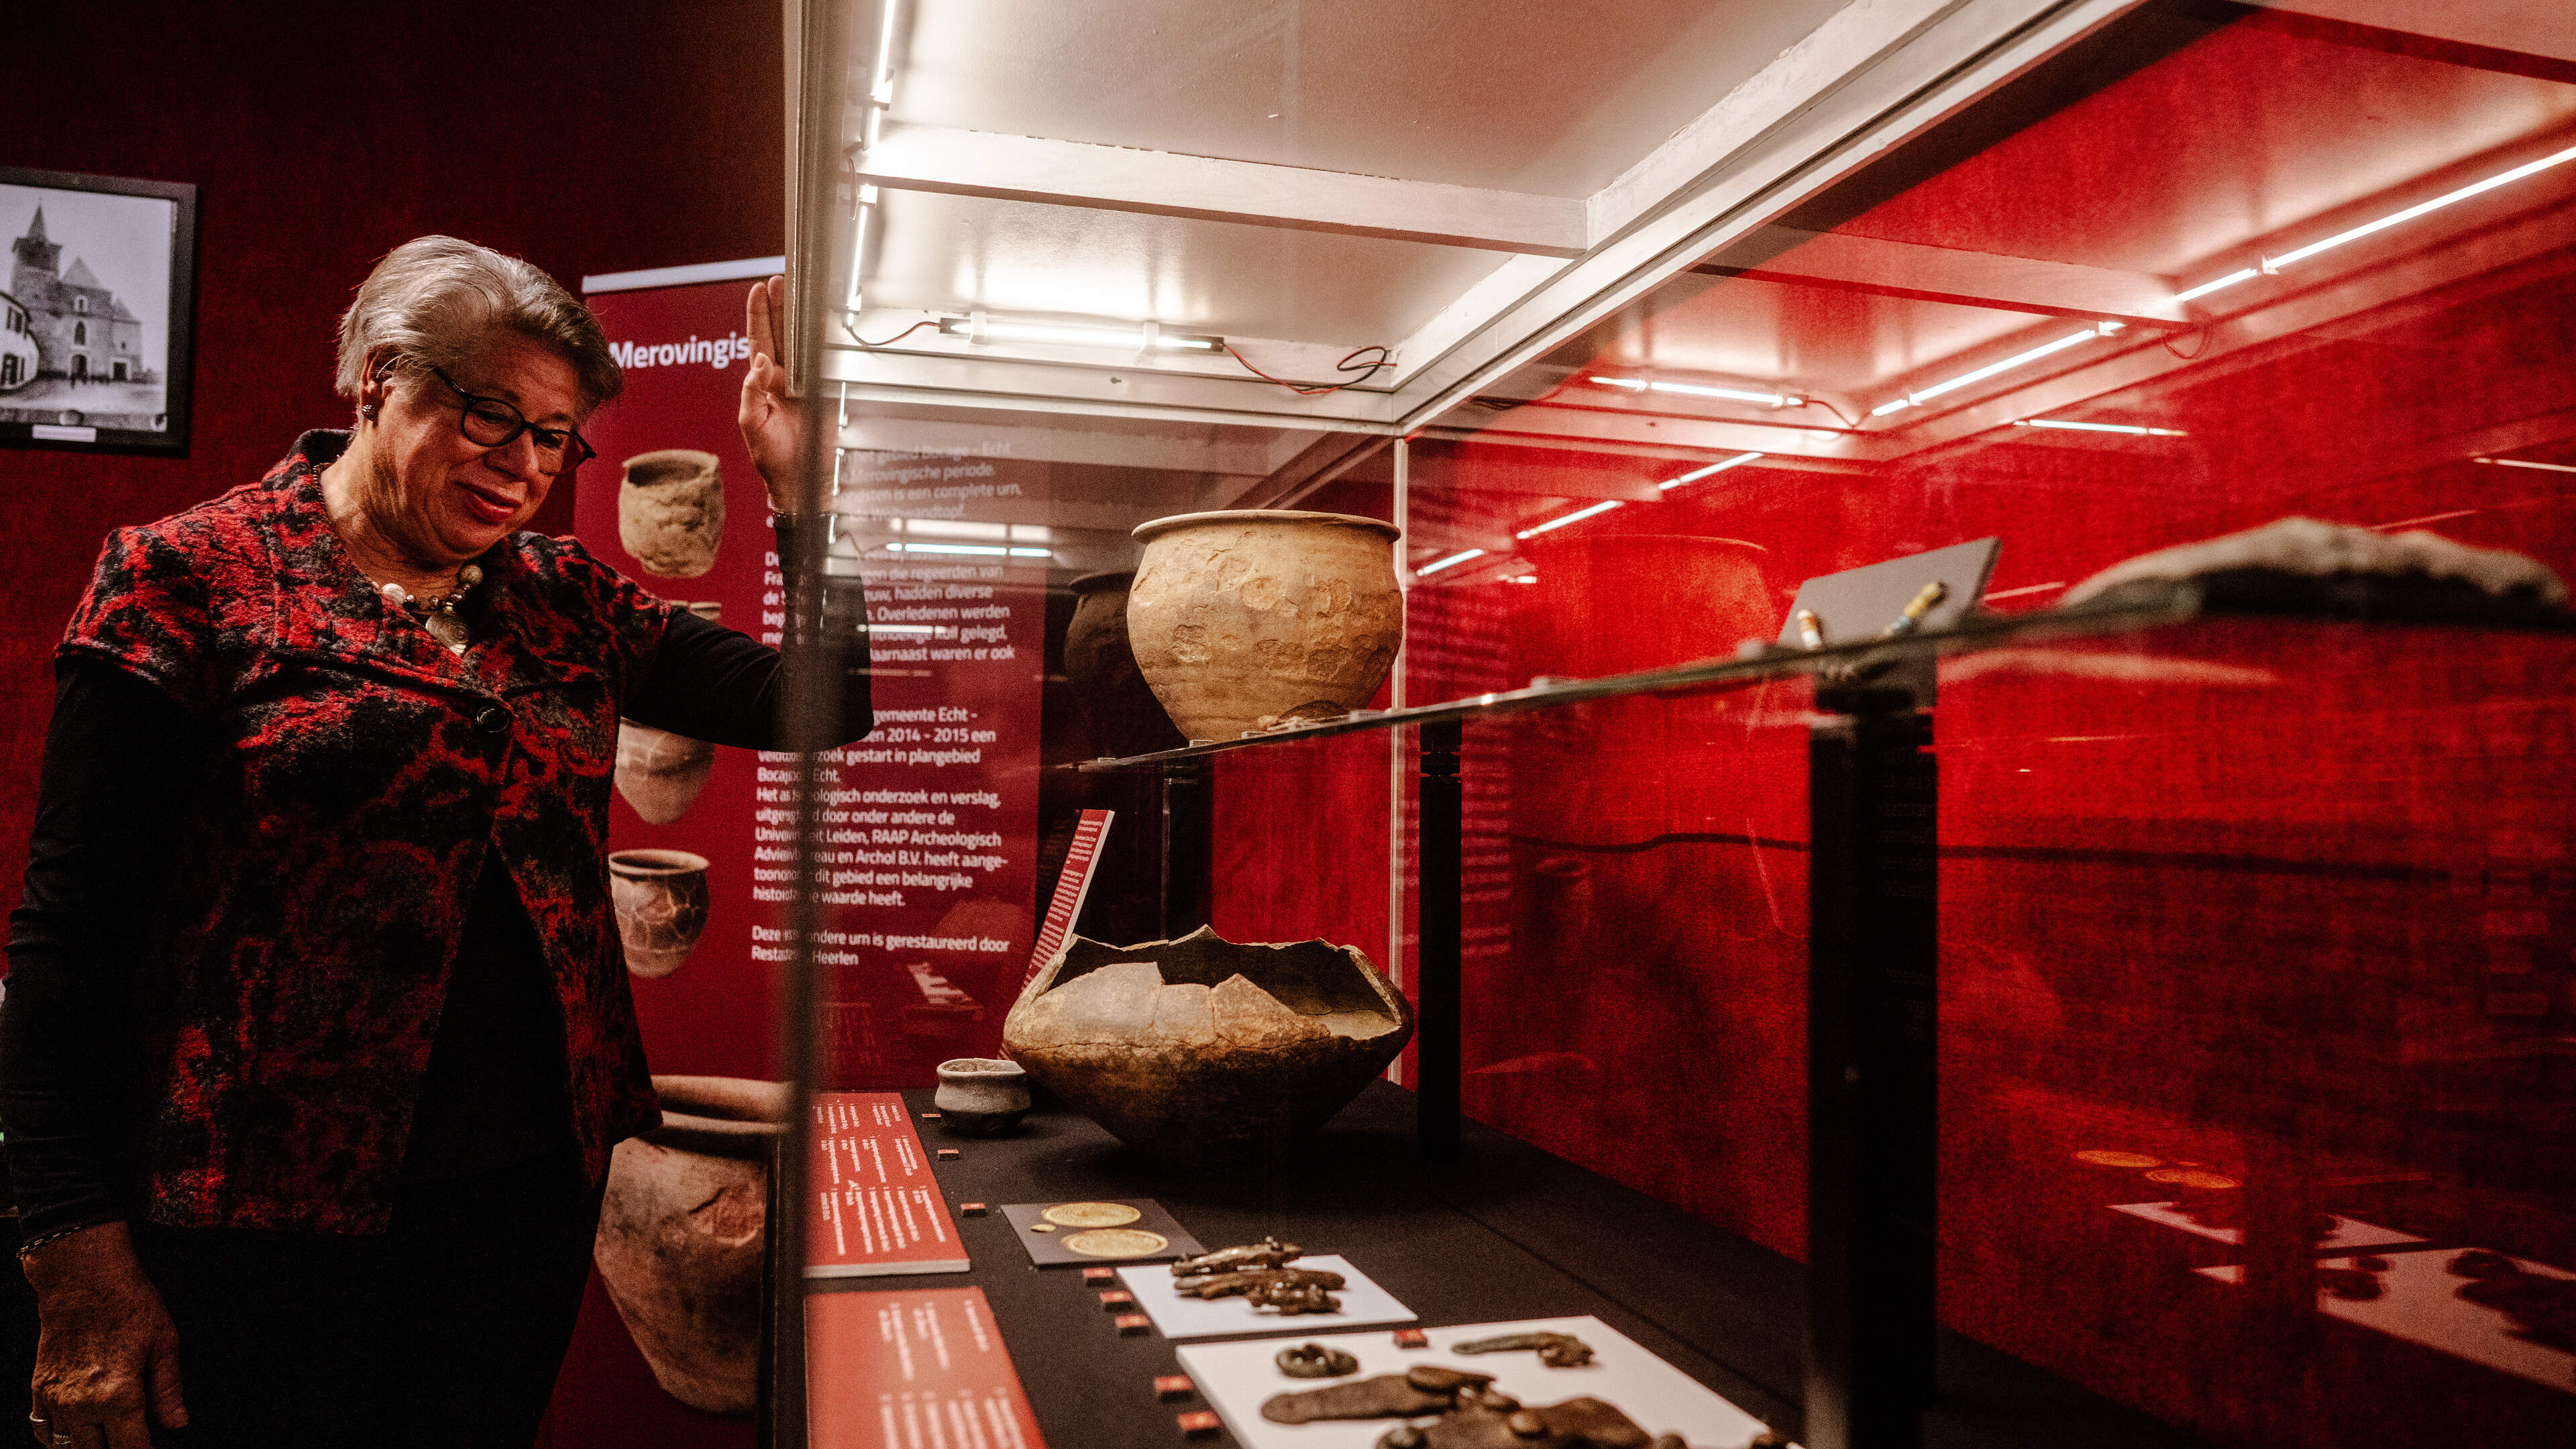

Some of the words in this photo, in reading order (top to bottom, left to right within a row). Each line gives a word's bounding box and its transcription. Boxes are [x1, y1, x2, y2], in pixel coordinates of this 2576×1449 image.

[608, 331, 750, 370] Merovingis
[894, 488, 904, 501] is
[907, 489, 932, 500] een
[933, 483, 995, 502] complete
[910, 566, 977, 584] regeerden
[979, 567, 1004, 579] van
[763, 590, 780, 606] de
[894, 586, 942, 600] hadden
[945, 584, 994, 599] diverse
[877, 605, 959, 622] Overledenen
[961, 604, 1011, 620] werden
[930, 648, 972, 661] waren
[974, 648, 989, 659] er
[990, 644, 1016, 660] ook
[872, 708, 936, 727] gemeente
[938, 706, 969, 722] Echt
[887, 727, 922, 743] 2014
[932, 727, 969, 743] 2015
[971, 730, 997, 743] een
[846, 748, 893, 767] gestart
[894, 747, 907, 763] in
[908, 747, 981, 767] plangebied
[757, 786, 778, 802] Het
[862, 788, 928, 805] onderzoek
[930, 792, 948, 804] en
[950, 790, 1002, 810] verslag,
[822, 807, 850, 822] door
[851, 808, 890, 824] onder
[890, 810, 936, 826] andere
[937, 810, 956, 826] de
[826, 827, 870, 845] Leiden,
[871, 829, 910, 845] RAAP
[910, 830, 1002, 851] Archeologisch
[837, 850, 853, 863] en
[855, 848, 897, 866] Archol
[898, 849, 922, 865] B.V.
[924, 851, 960, 868] heeft
[961, 855, 1009, 873] aange-
[832, 869, 875, 888] gebied
[875, 873, 900, 886] een
[902, 869, 974, 892] belangrijke
[821, 889, 867, 905] waarde
[868, 890, 906, 907] heeft.
[751, 924, 782, 942] Deze
[872, 931, 885, 947] is
[885, 934, 978, 952] gerestaureerd
[979, 936, 1011, 953] door
[812, 949, 860, 966] Heerlen
